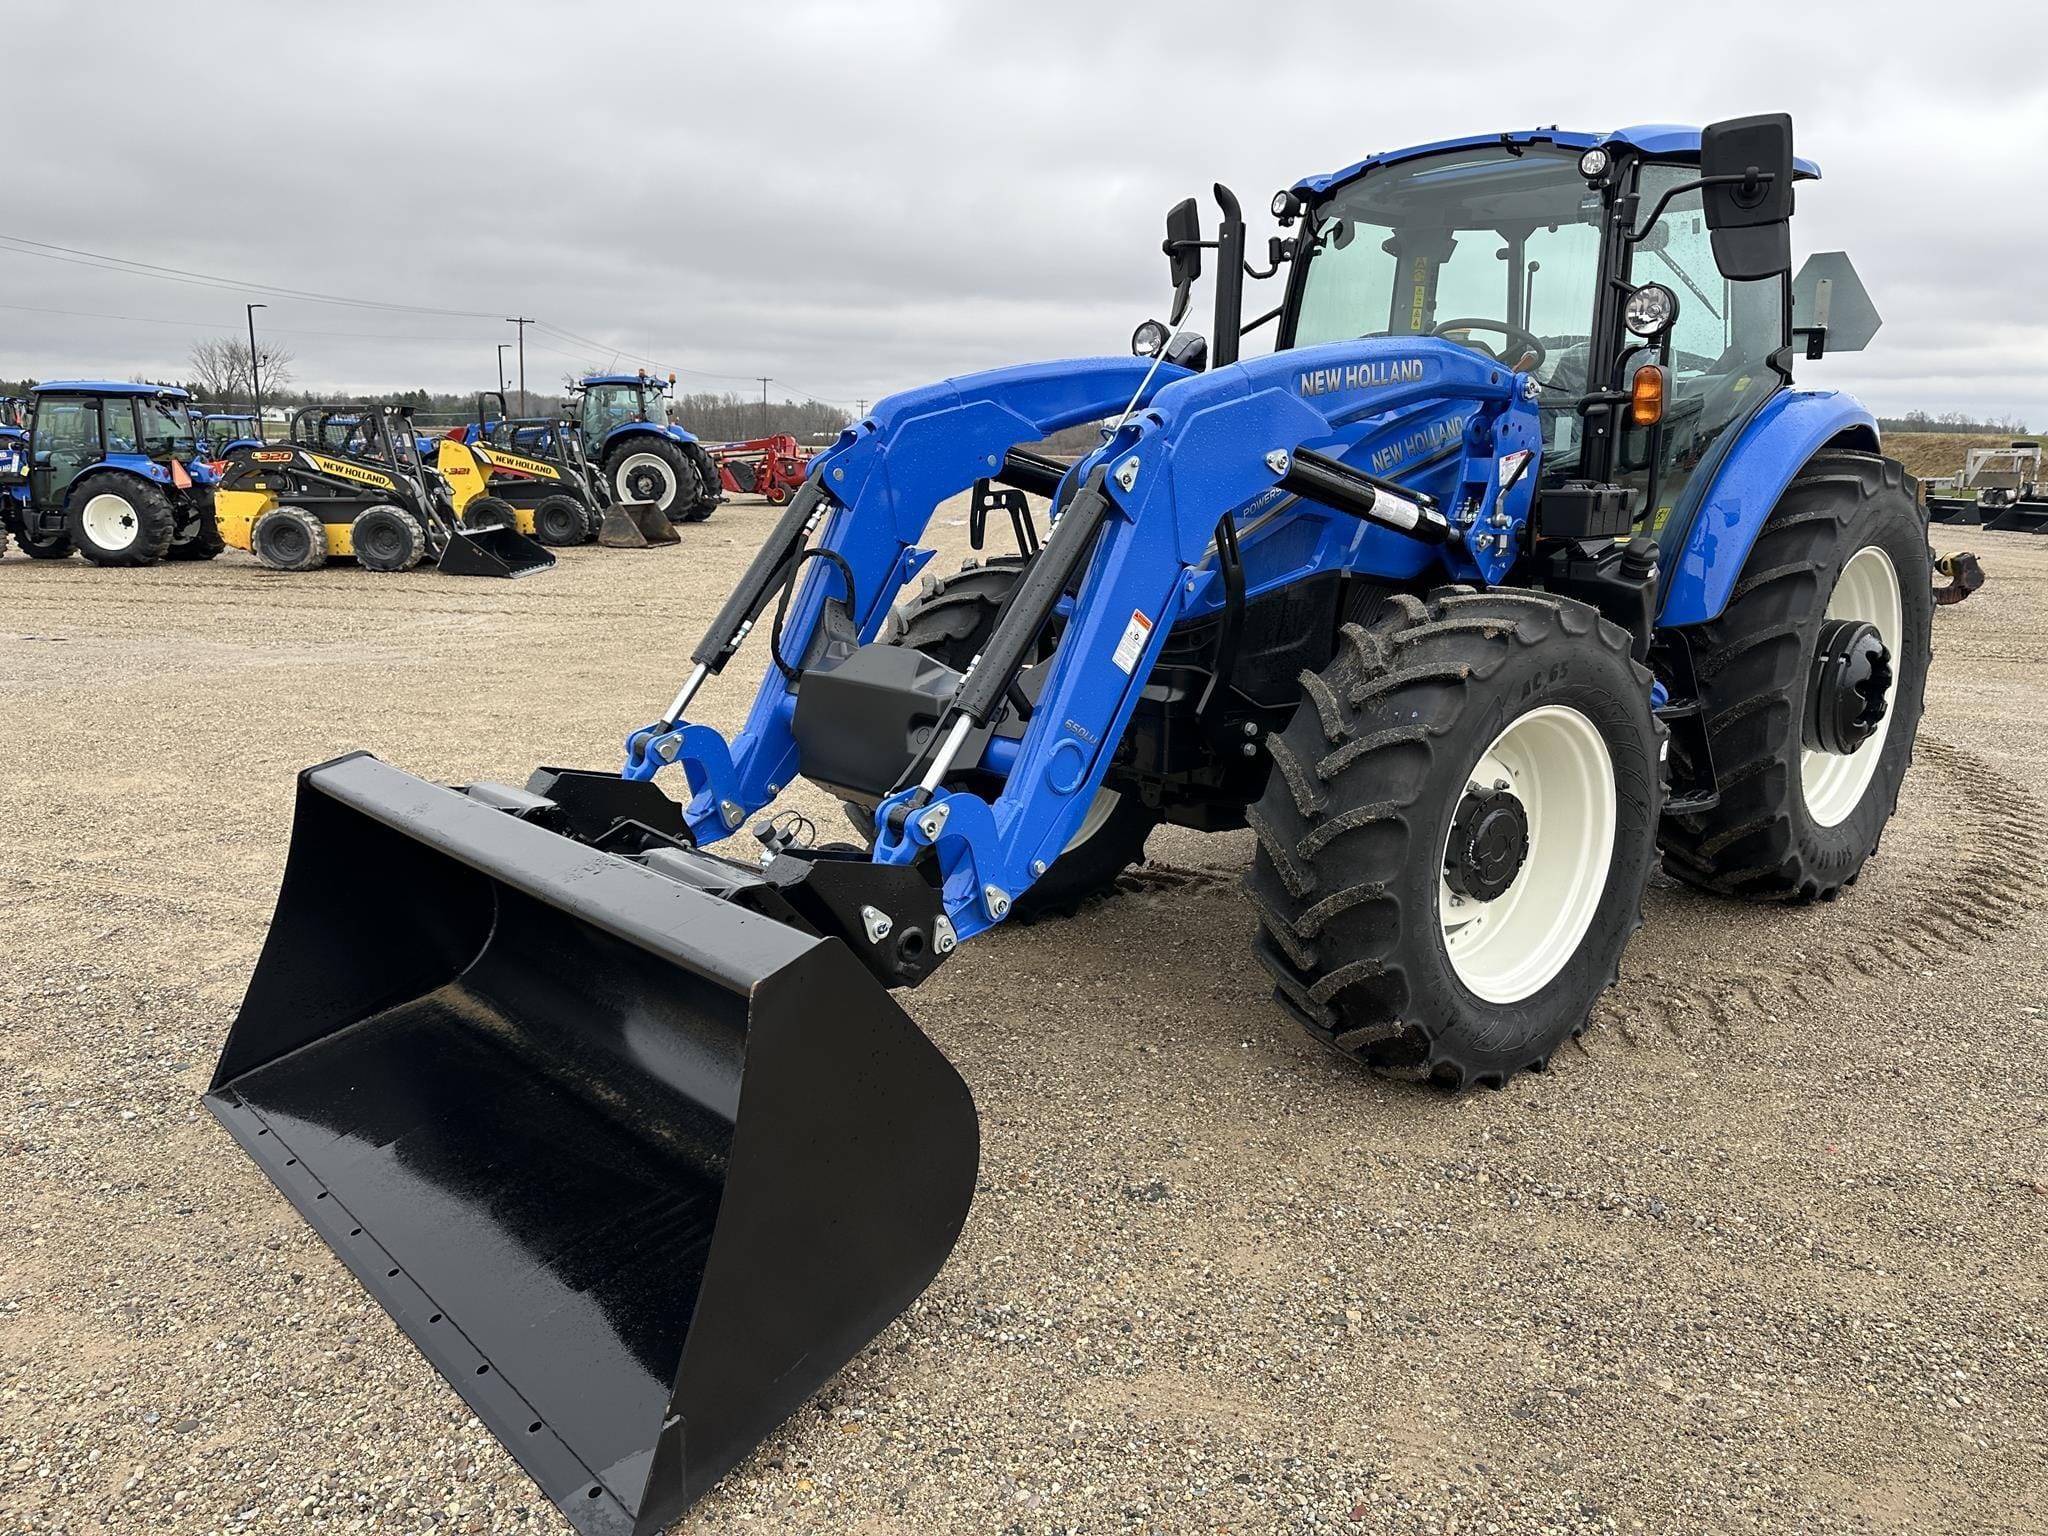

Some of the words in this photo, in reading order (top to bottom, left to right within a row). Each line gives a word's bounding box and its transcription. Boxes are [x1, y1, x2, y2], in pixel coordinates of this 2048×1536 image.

[1301, 368, 1341, 397] NEW
[1346, 359, 1423, 389] HOLLAND
[1371, 445, 1401, 474] NEW
[1405, 416, 1464, 458] HOLLAND
[322, 461, 344, 473] NEW
[345, 468, 386, 485] HOLLAND
[495, 455, 515, 466] NEW
[515, 461, 552, 475] HOLLAND
